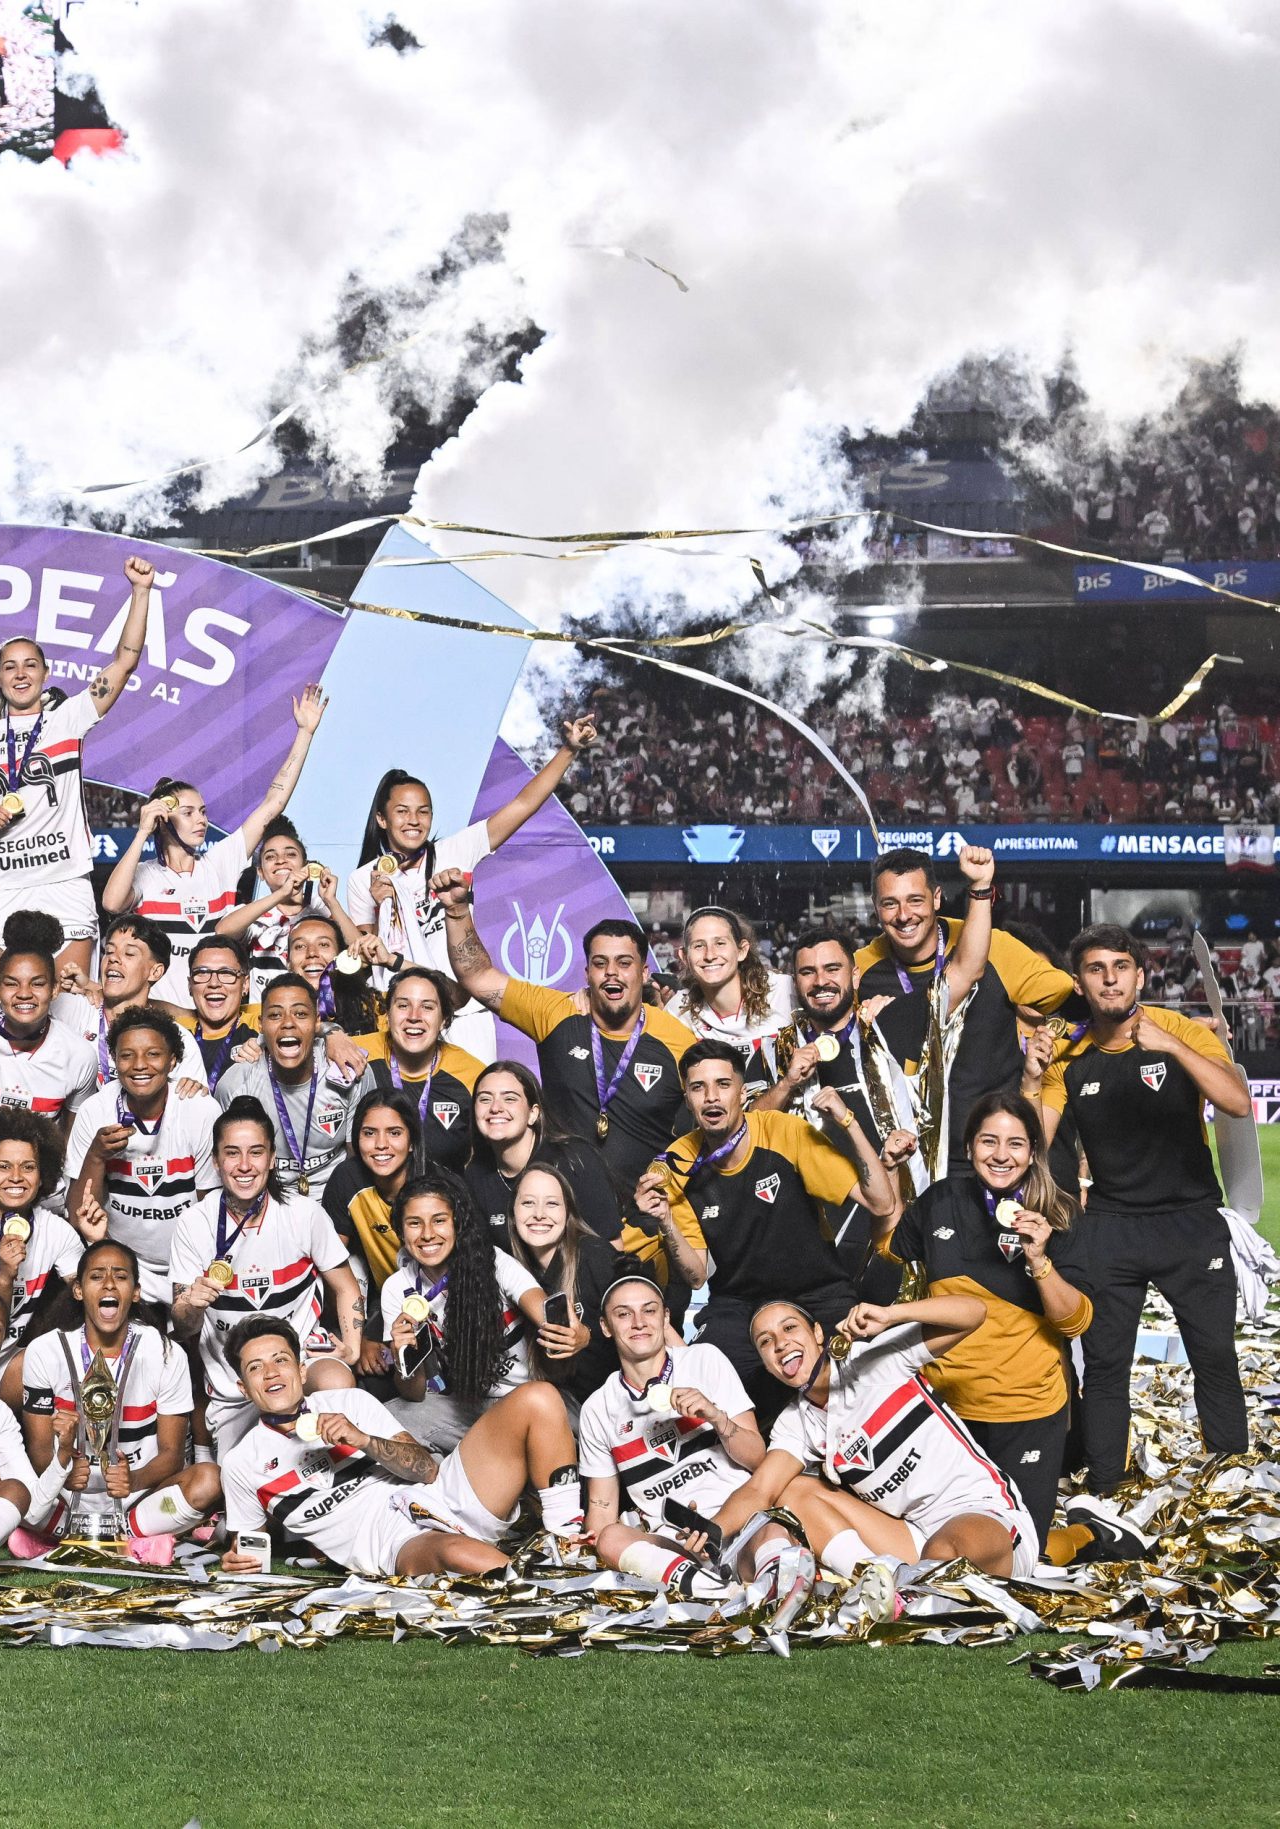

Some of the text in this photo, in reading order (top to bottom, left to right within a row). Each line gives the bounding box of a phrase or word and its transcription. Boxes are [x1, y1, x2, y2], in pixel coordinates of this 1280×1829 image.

[151, 680, 182, 705] A1
[878, 832, 934, 844] SEGUROS
[635, 1065, 661, 1075] SPFC
[1141, 1065, 1164, 1076] SPFC
[1250, 1086, 1280, 1098] PFC
[1, 1096, 28, 1108] SPFC
[435, 1104, 459, 1112] SPFC
[319, 1111, 343, 1124] SPFC
[136, 1165, 164, 1176] SPFC
[755, 1177, 779, 1192] SPFC
[110, 1199, 192, 1222] SUPERBET
[1001, 1236, 1020, 1244] SPF
[242, 1278, 270, 1288] SPFC
[650, 1431, 677, 1448] SPFC
[844, 1436, 867, 1460] SPFC
[301, 1458, 329, 1479] SPFC
[643, 1457, 718, 1501] SUPERBET
